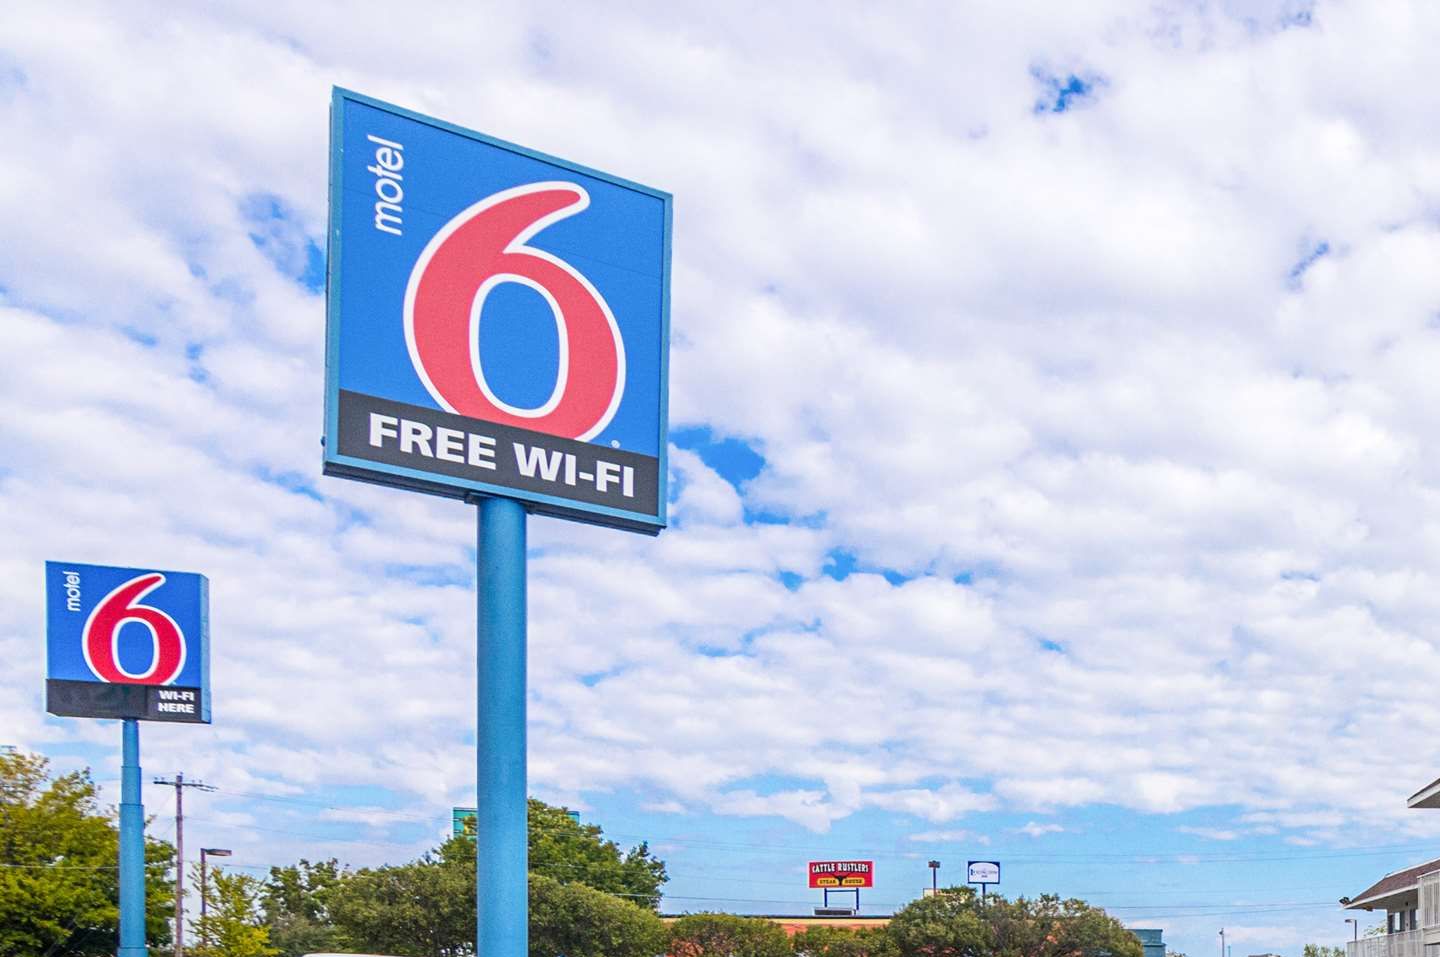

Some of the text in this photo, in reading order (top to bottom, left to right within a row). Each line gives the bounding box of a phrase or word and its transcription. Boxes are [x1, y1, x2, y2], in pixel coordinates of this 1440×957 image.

[367, 134, 627, 442] motel 6
[368, 412, 635, 498] FREE WI-FI
[63, 571, 187, 686] motel 6
[157, 702, 195, 713] HERE
[158, 690, 195, 701] WI-FI
[812, 863, 869, 873] CATTLE RUSTLERS
